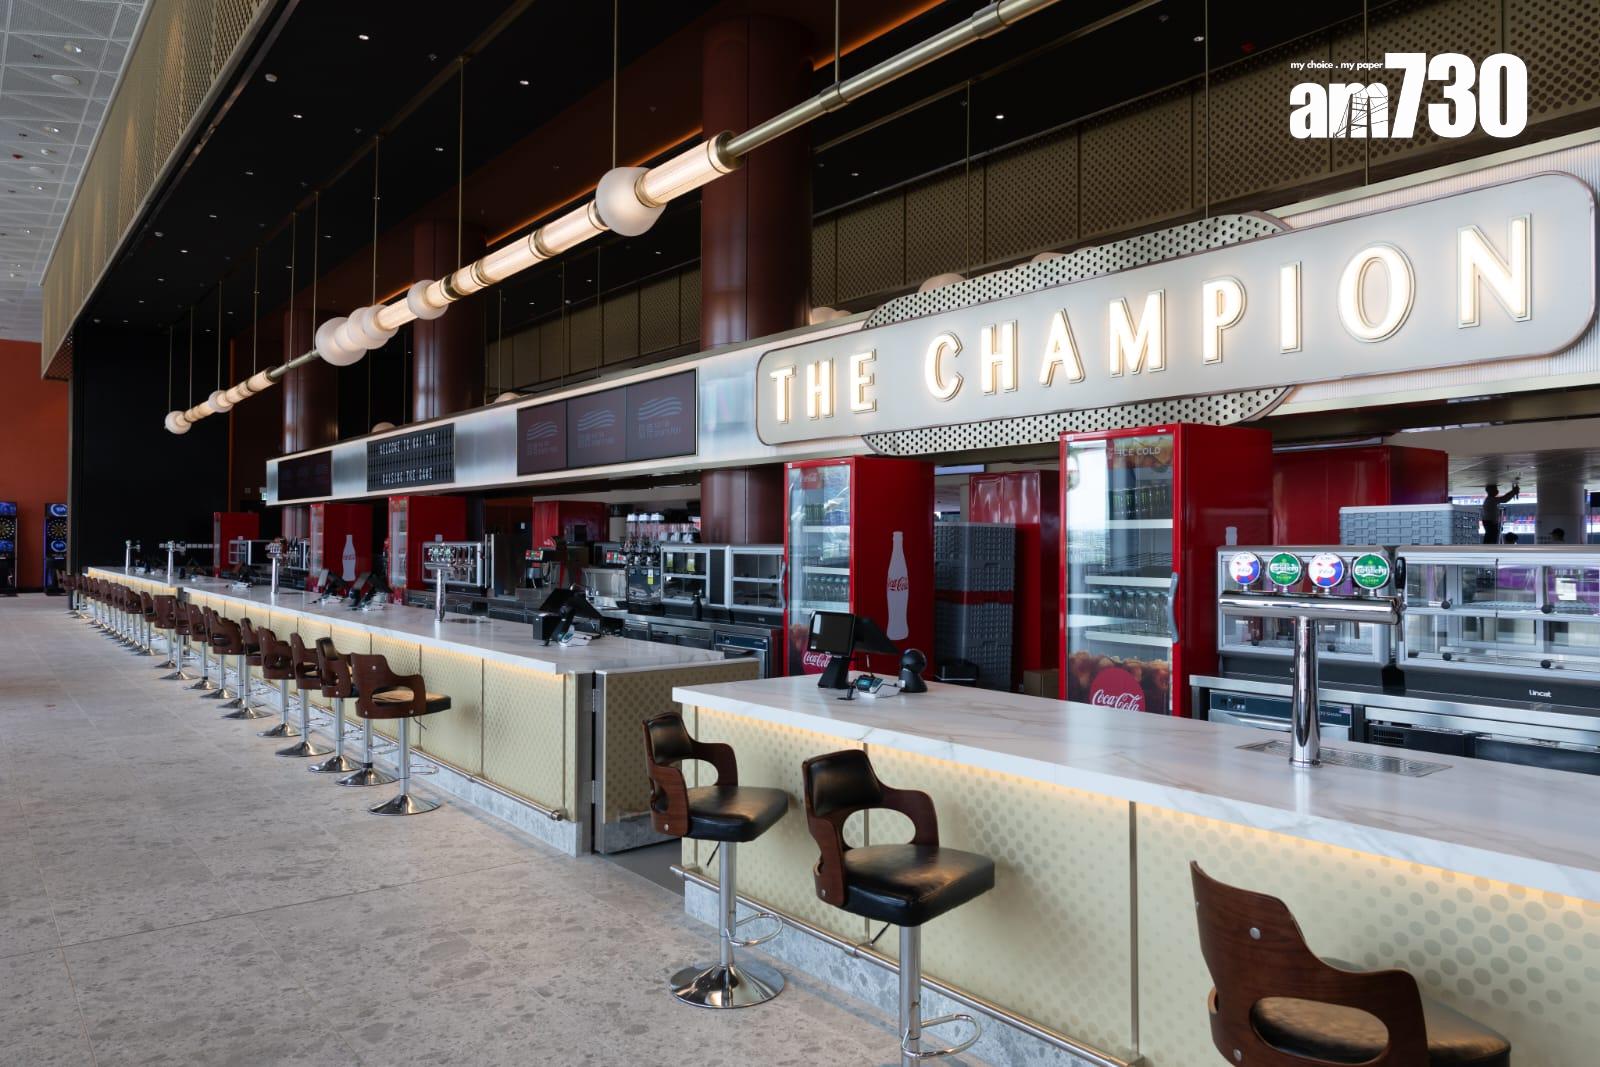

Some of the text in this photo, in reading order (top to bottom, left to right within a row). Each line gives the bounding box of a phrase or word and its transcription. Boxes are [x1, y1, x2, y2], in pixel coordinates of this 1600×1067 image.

[769, 212, 1534, 425] THE CHAMPION
[1136, 446, 1161, 456] COLD
